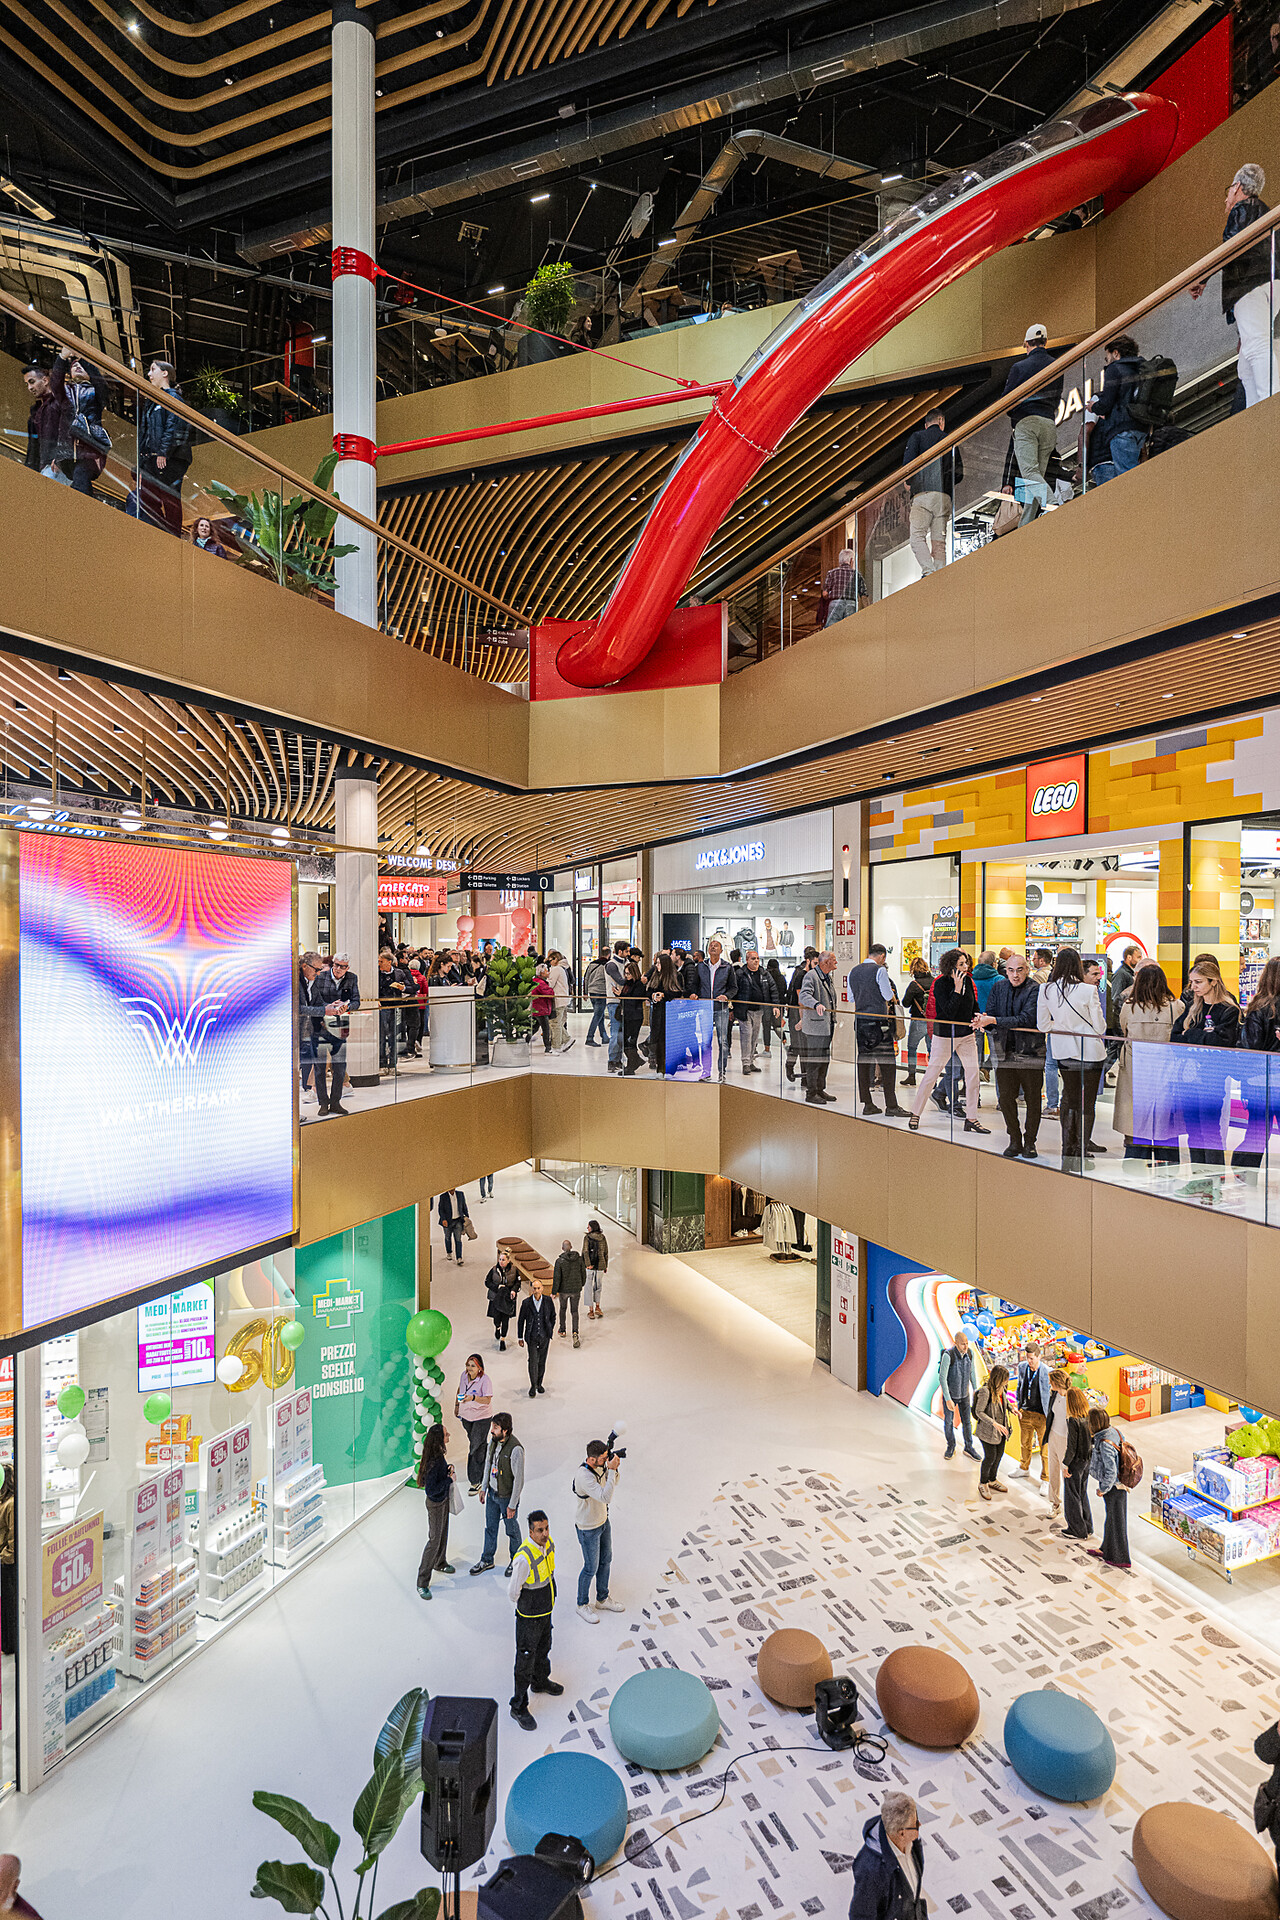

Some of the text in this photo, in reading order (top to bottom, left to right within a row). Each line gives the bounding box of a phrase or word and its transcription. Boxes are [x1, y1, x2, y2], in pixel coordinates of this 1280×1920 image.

[1032, 781, 1078, 815] LEGO
[388, 854, 457, 871] WELCOME DESK
[696, 841, 765, 870] JACK&JONES
[379, 883, 430, 893] MERCATO
[540, 876, 548, 890] 0
[378, 895, 424, 907] CENTRALE
[101, 1086, 242, 1127] WALTHERPARK
[317, 1295, 359, 1309] MEDI-MARKET
[320, 1343, 357, 1361] PREZZO
[321, 1361, 355, 1379] SCELTA
[312, 1377, 364, 1399] CONSIGLIO
[1174, 1389, 1188, 1397] Disney
[47, 1535, 68, 1557] FOLLIE
[68, 1517, 100, 1544] D'AUTUNNO
[54, 1553, 91, 1592] -50%
[52, 1609, 64, 1624] 400
[81, 1587, 100, 1605] SHOCK
